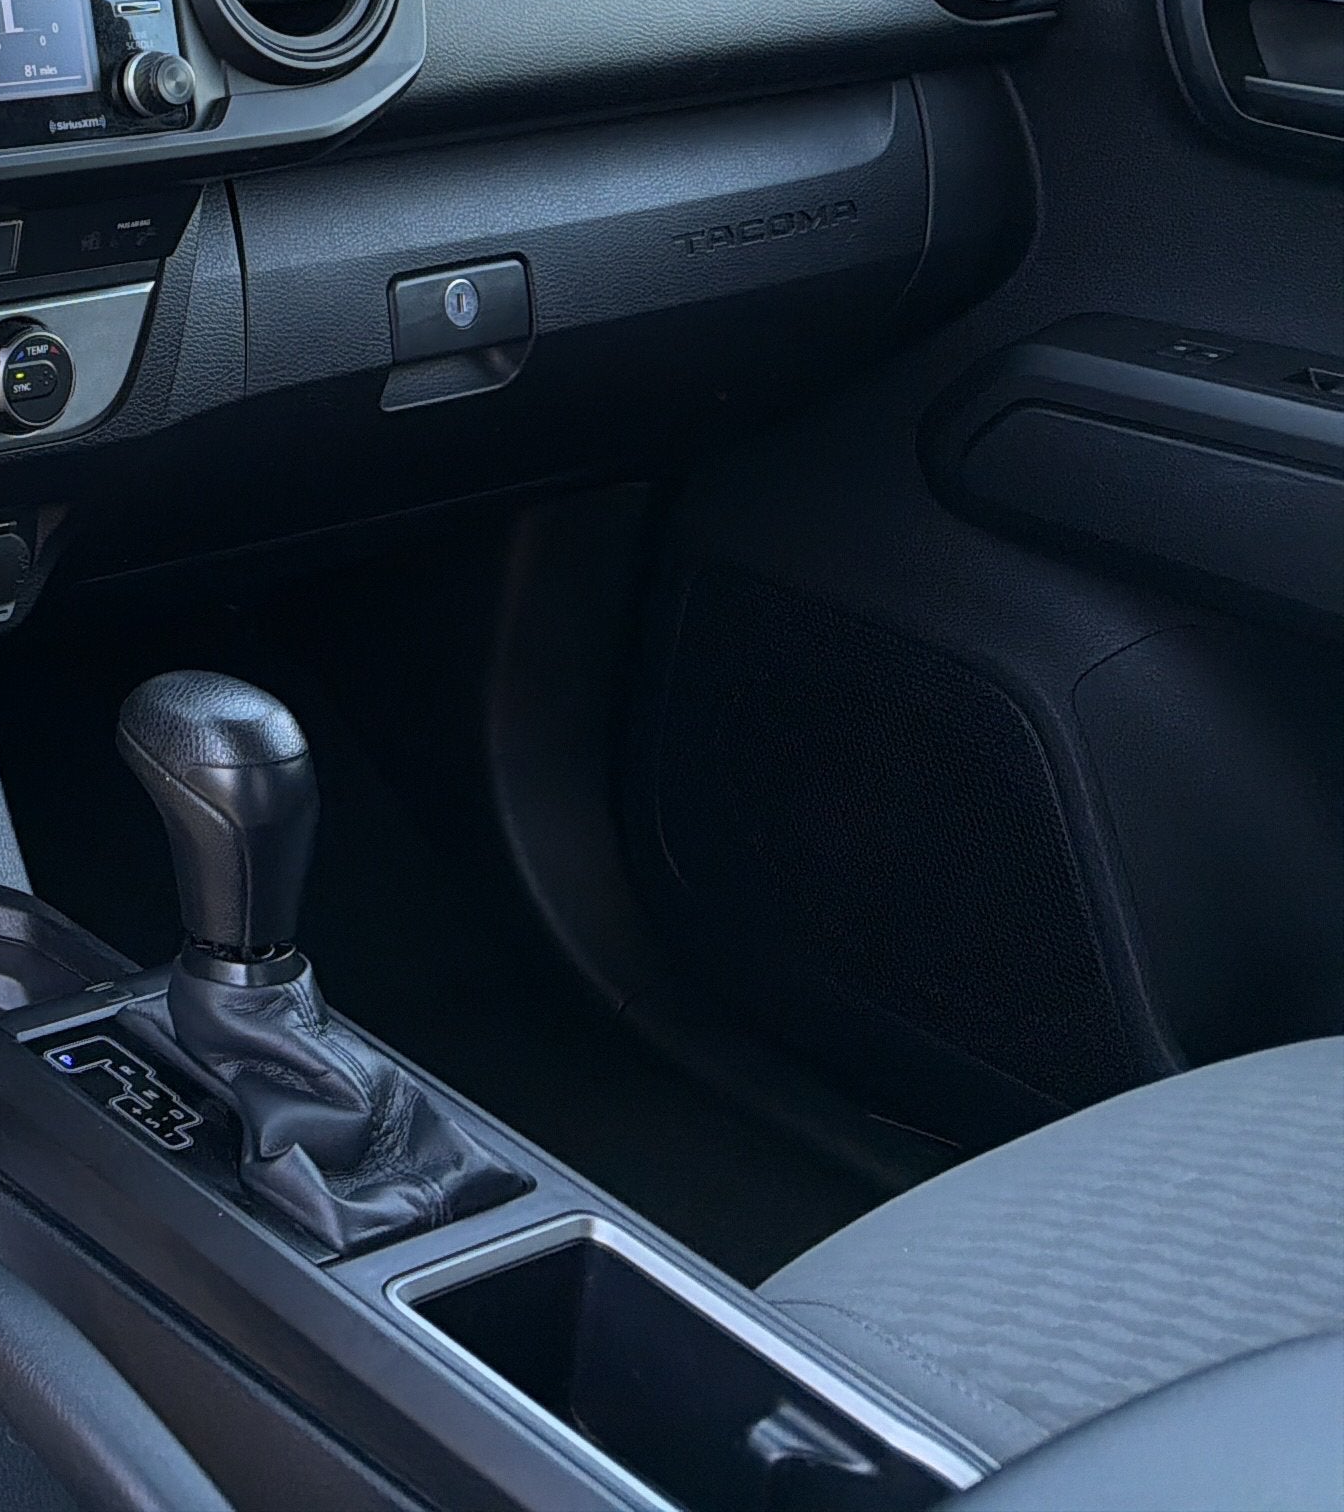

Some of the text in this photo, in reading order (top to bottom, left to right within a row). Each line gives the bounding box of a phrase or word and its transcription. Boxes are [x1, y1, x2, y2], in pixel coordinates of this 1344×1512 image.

[52, 22, 59, 33] 0
[39, 36, 47, 46] 0
[24, 65, 37, 77] 81
[671, 200, 858, 257] TACOMA
[26, 344, 49, 356] TEMP
[13, 383, 31, 393] SYNC
